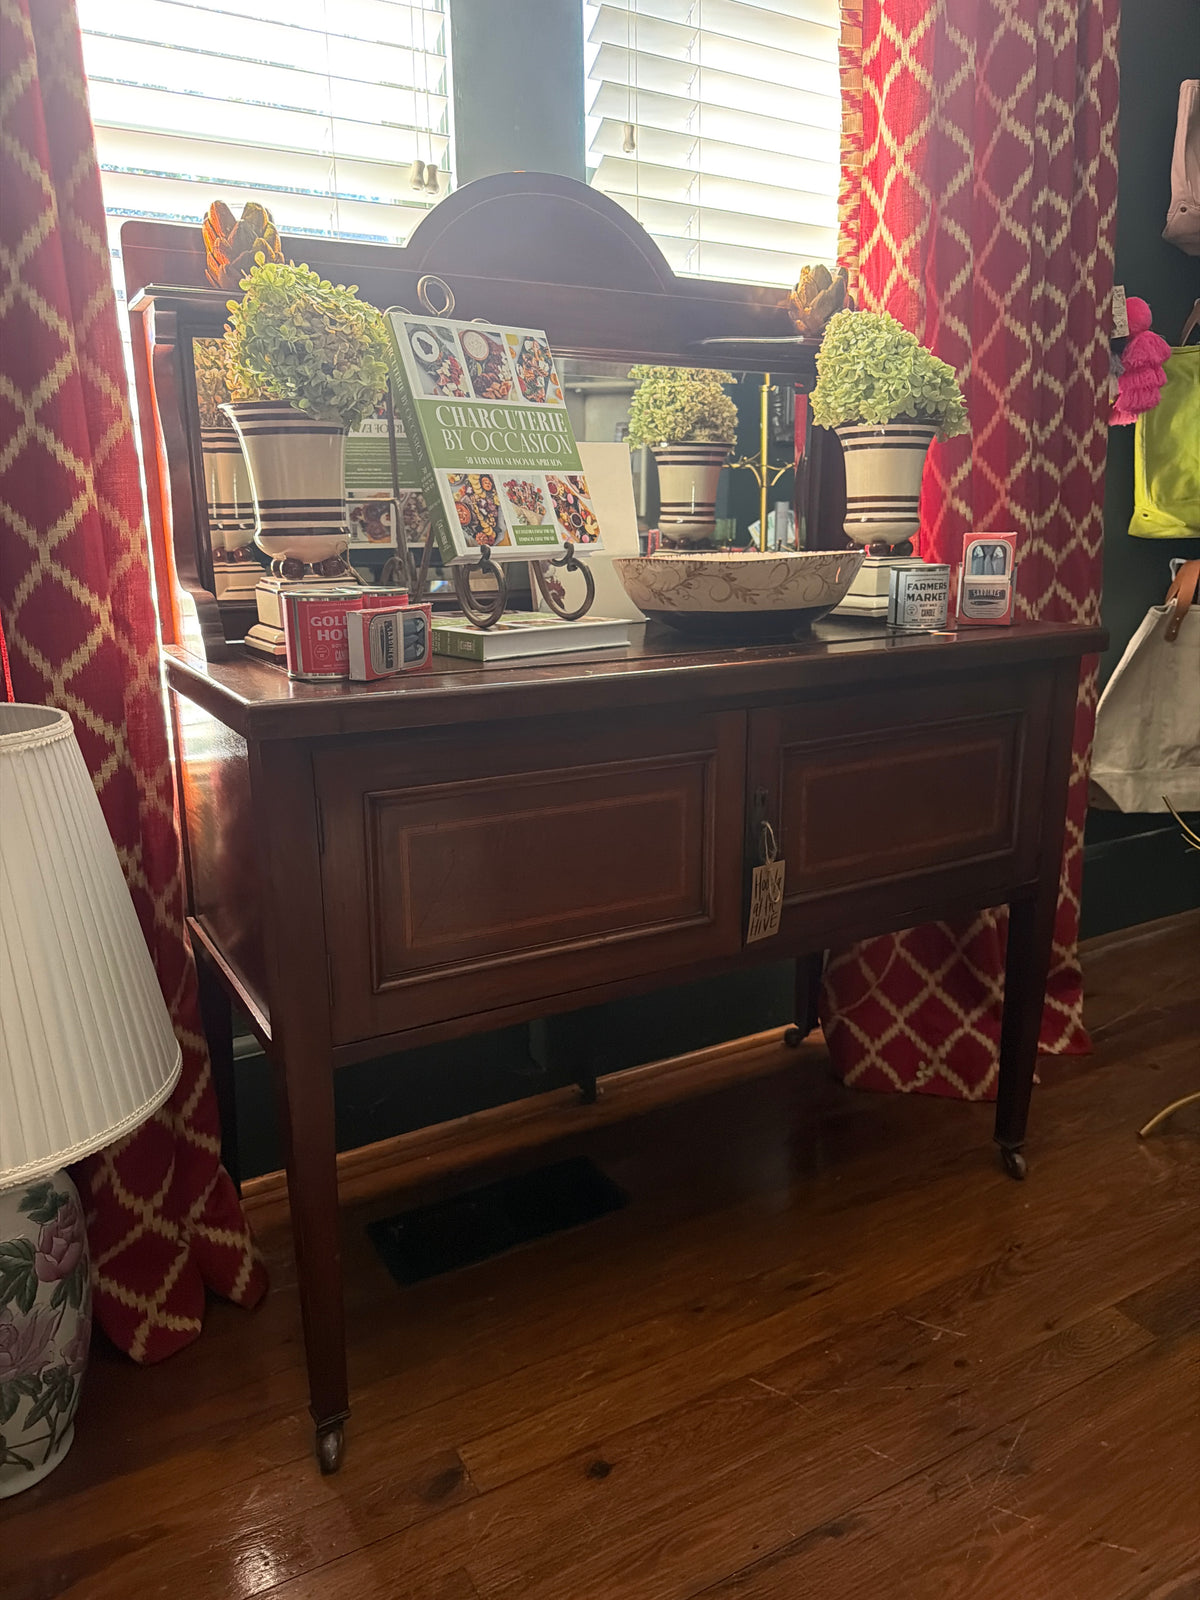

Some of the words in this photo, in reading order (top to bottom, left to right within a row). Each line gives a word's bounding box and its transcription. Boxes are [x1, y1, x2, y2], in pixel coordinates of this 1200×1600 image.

[435, 405, 568, 432] CHARCUTERIE
[441, 428, 464, 451] BY
[470, 430, 572, 454] OCCASION
[906, 592, 947, 602] MARKET
[907, 582, 948, 591] FARMERS
[749, 911, 778, 937] HIVE
